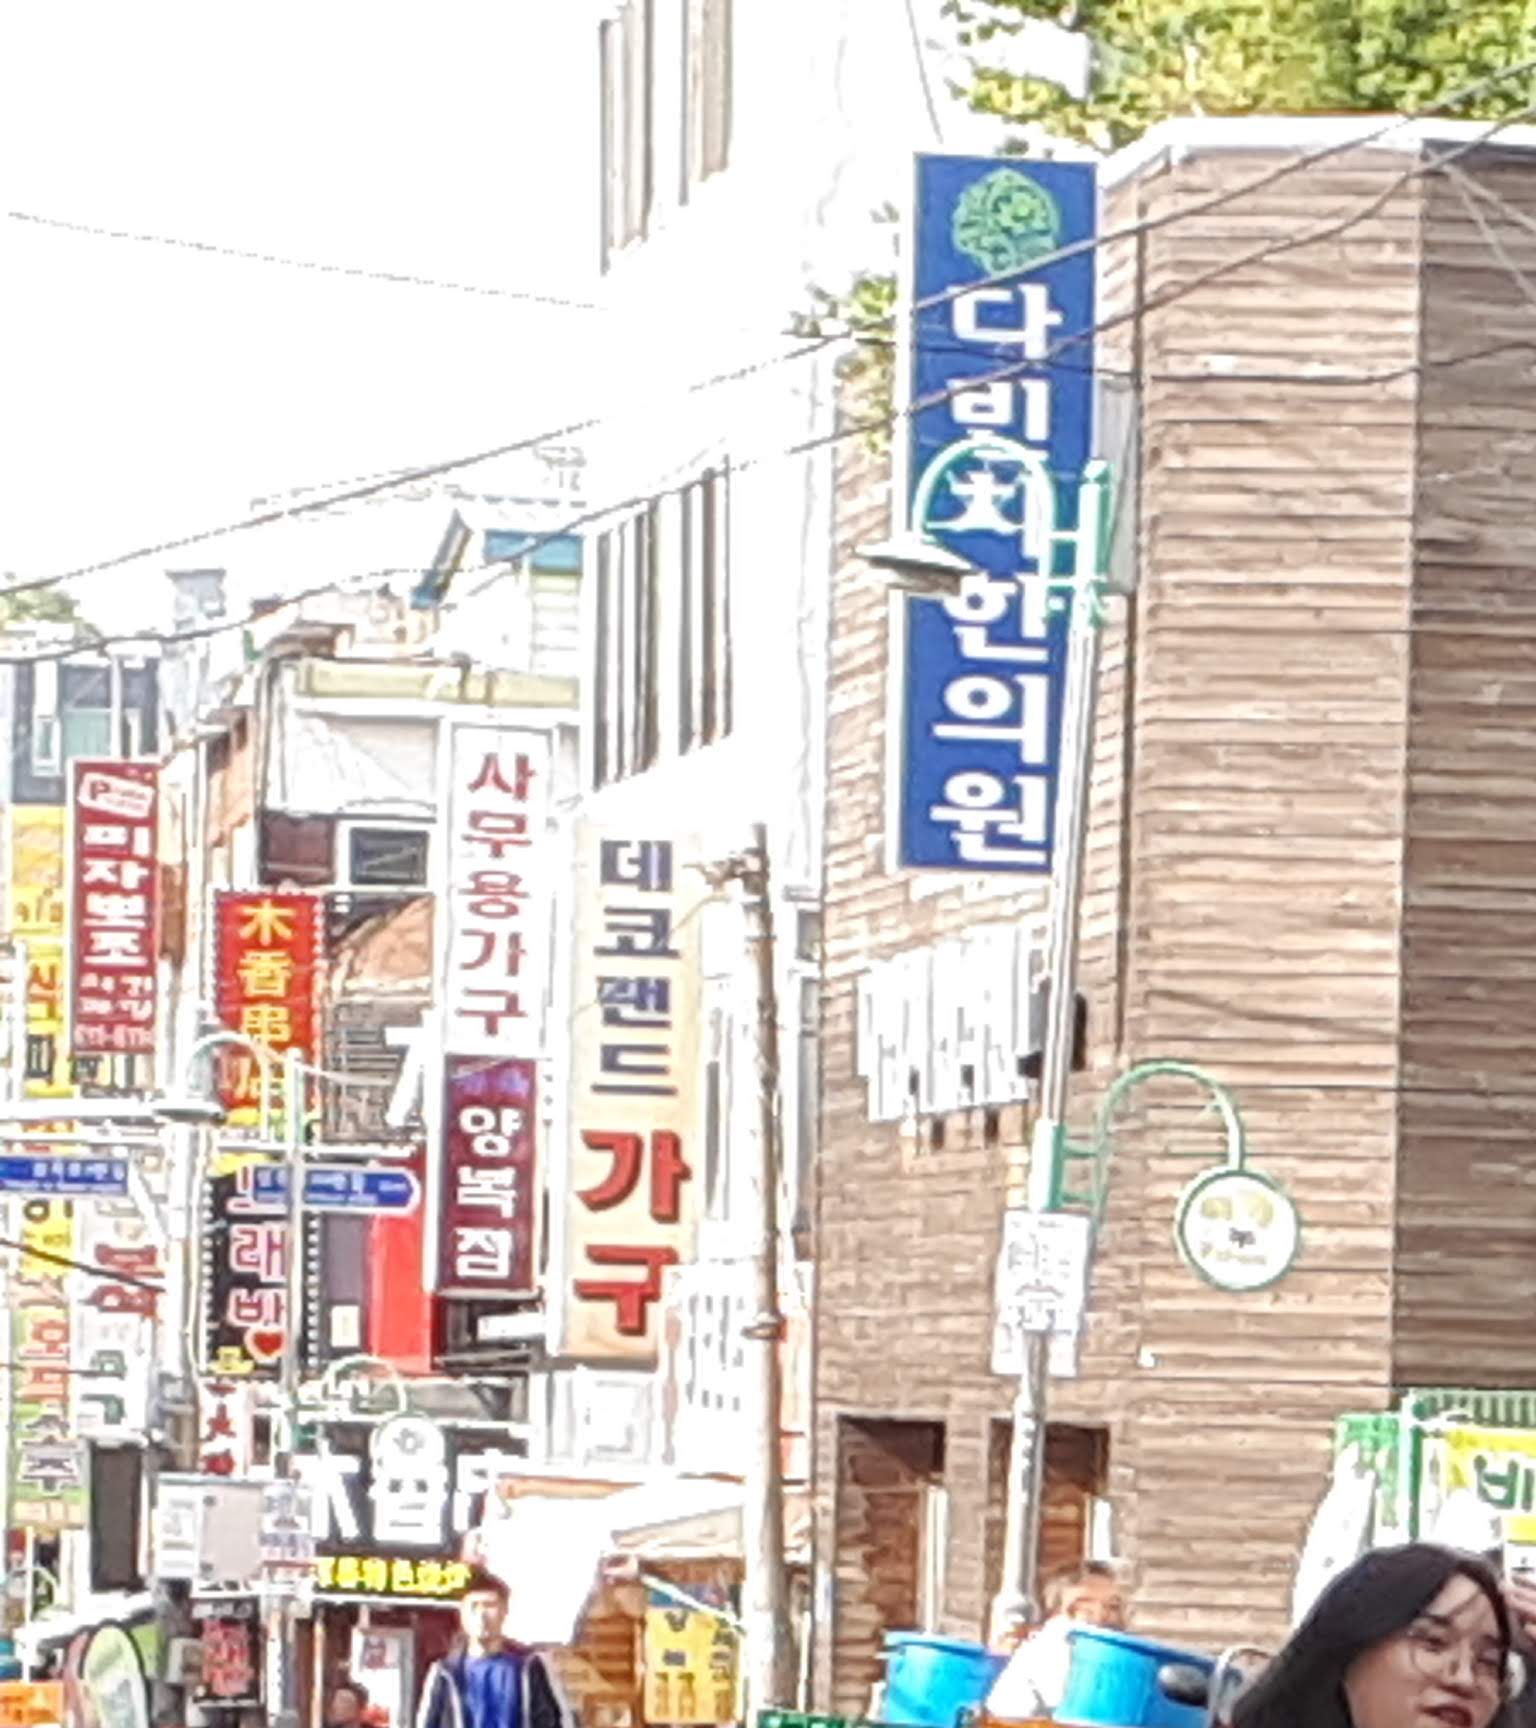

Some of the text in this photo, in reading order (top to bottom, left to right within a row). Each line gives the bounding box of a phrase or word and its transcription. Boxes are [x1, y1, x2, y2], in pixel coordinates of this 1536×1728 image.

[460, 753, 536, 1037] 사무용가구
[456, 1105, 523, 1281] 양복점
[573, 1128, 692, 1337] 가구
